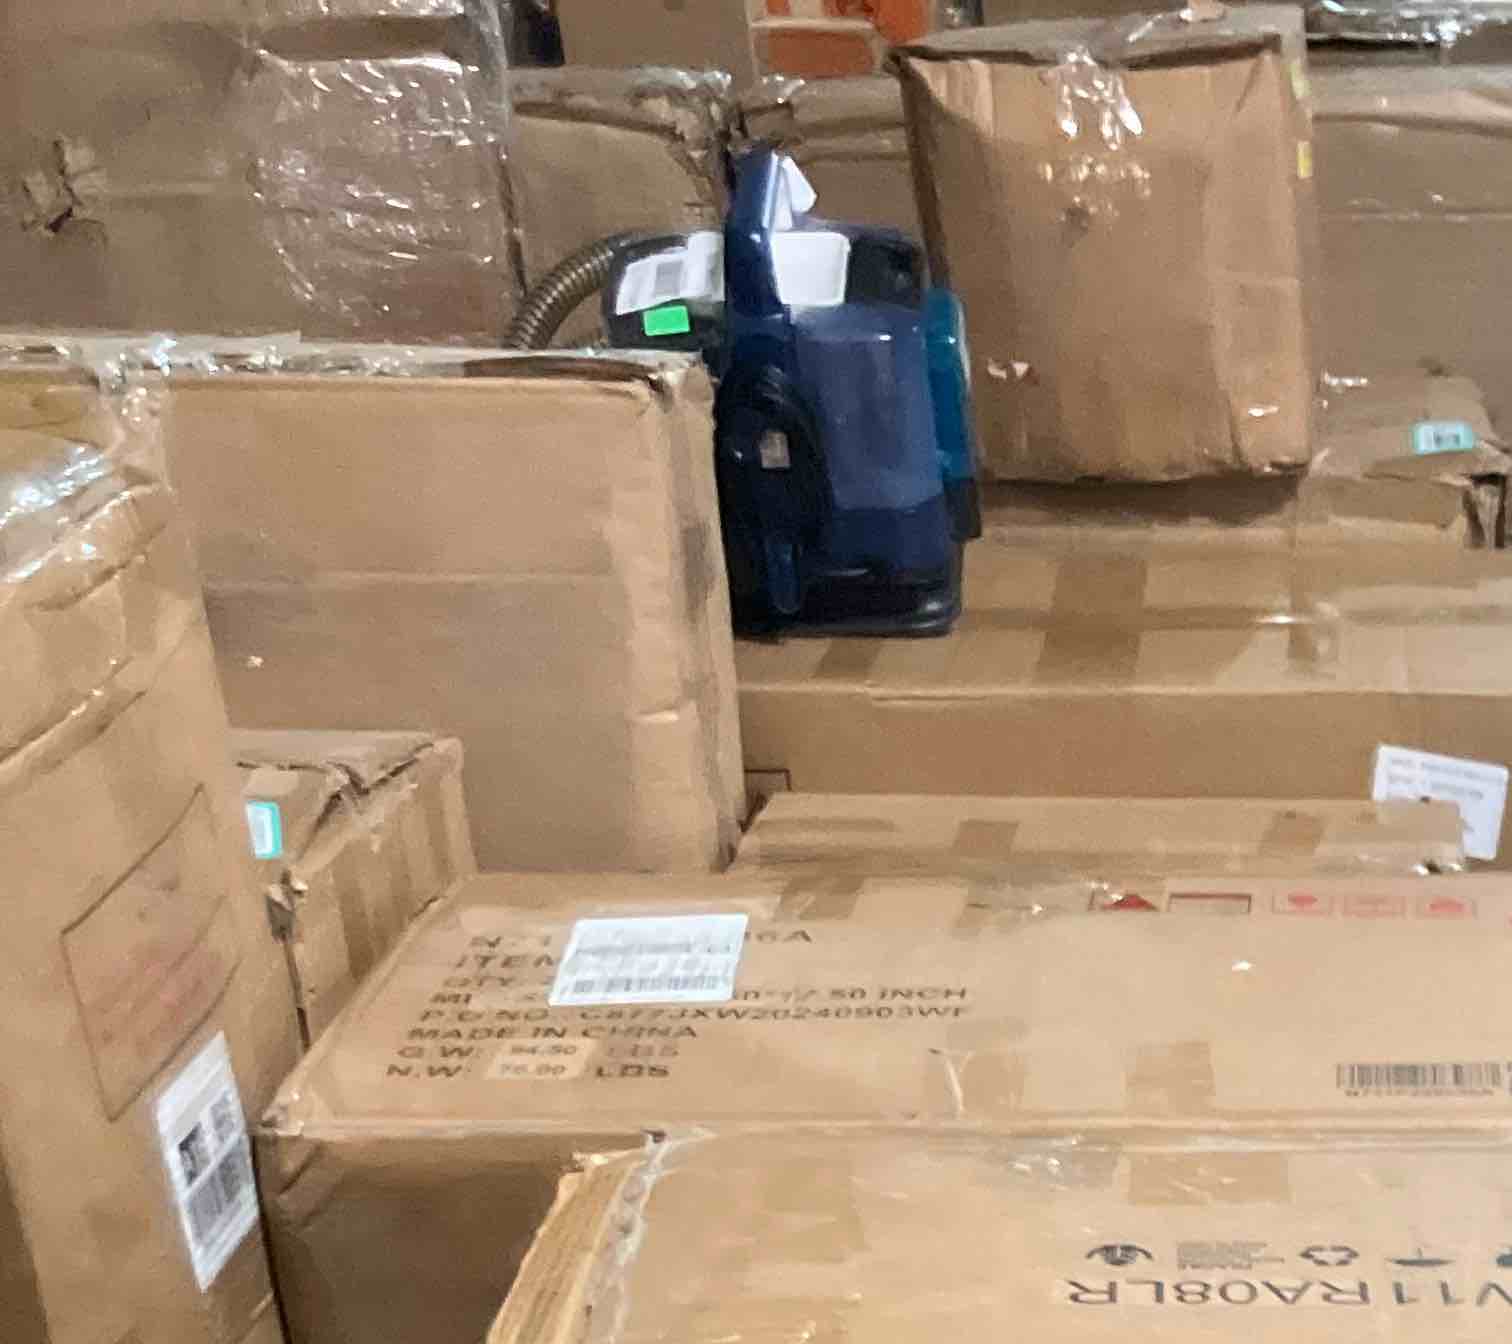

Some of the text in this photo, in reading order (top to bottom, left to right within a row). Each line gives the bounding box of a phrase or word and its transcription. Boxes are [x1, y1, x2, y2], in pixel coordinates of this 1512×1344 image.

[408, 1025, 697, 1041] MADE IN CHINA
